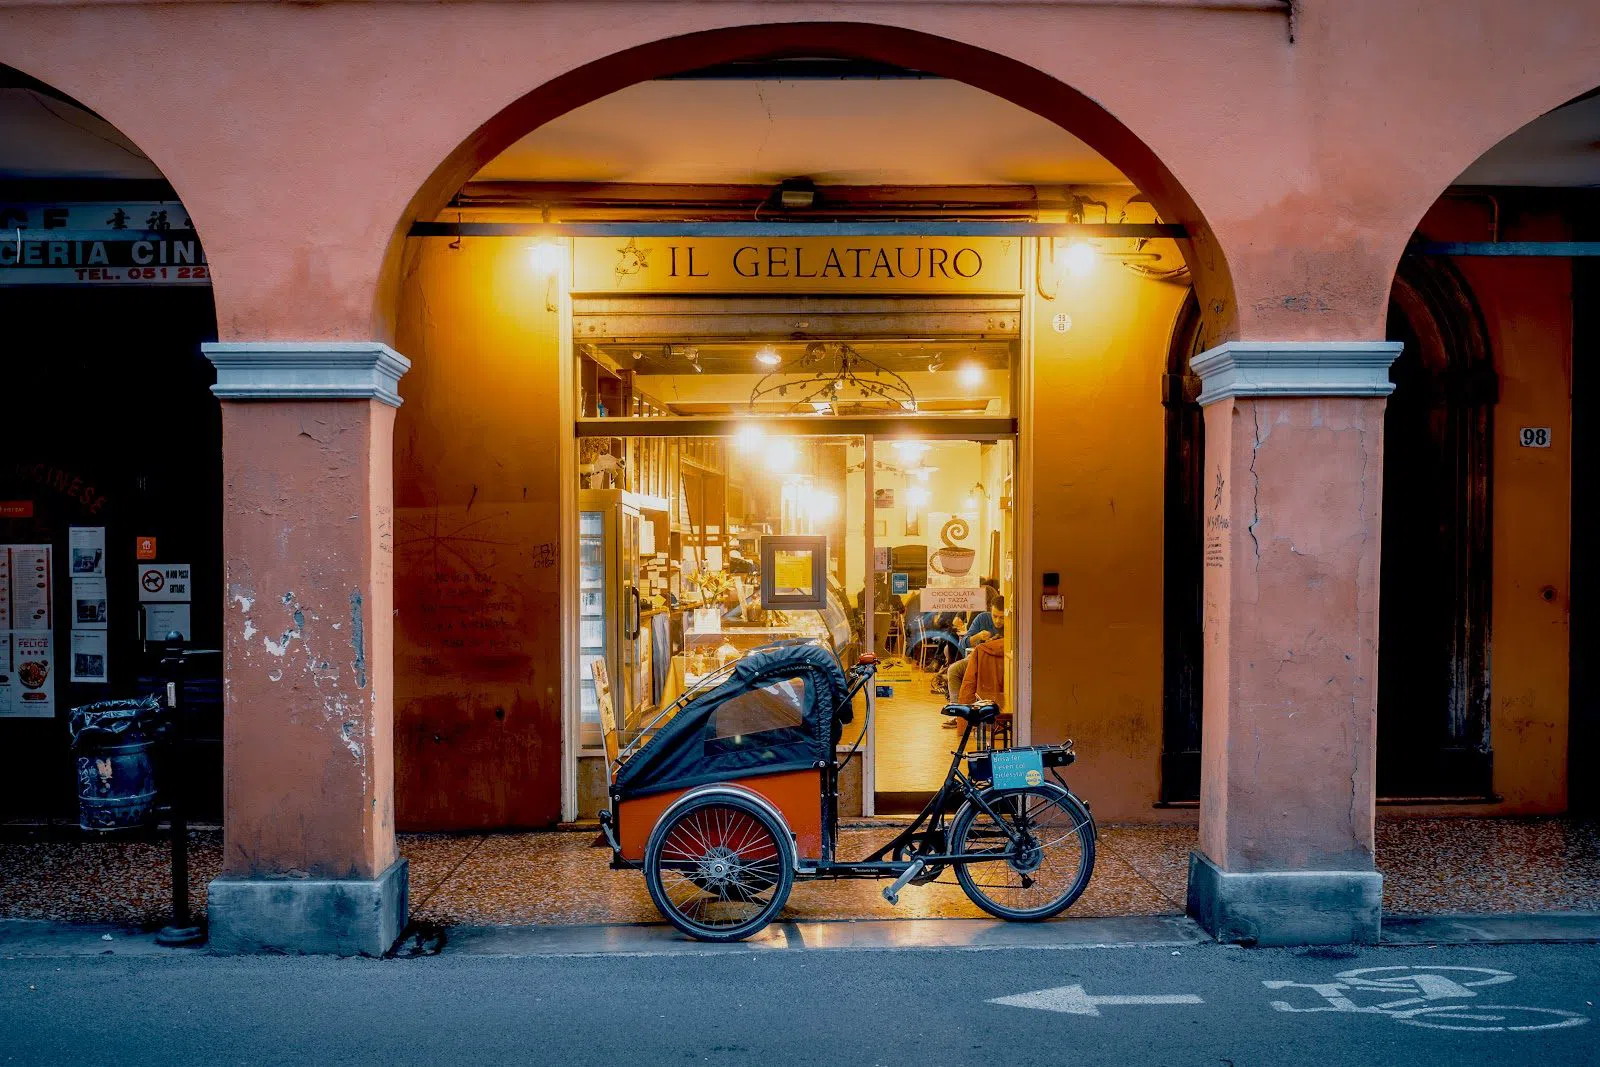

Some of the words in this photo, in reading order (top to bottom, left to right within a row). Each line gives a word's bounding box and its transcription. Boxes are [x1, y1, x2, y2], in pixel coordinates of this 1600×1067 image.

[131, 240, 211, 265] CIN
[667, 246, 709, 277] IL
[732, 245, 983, 279] GELATAURO
[75, 268, 121, 281] TEL.
[127, 267, 168, 280] 051
[177, 266, 212, 280] 22
[1523, 428, 1547, 446] 98
